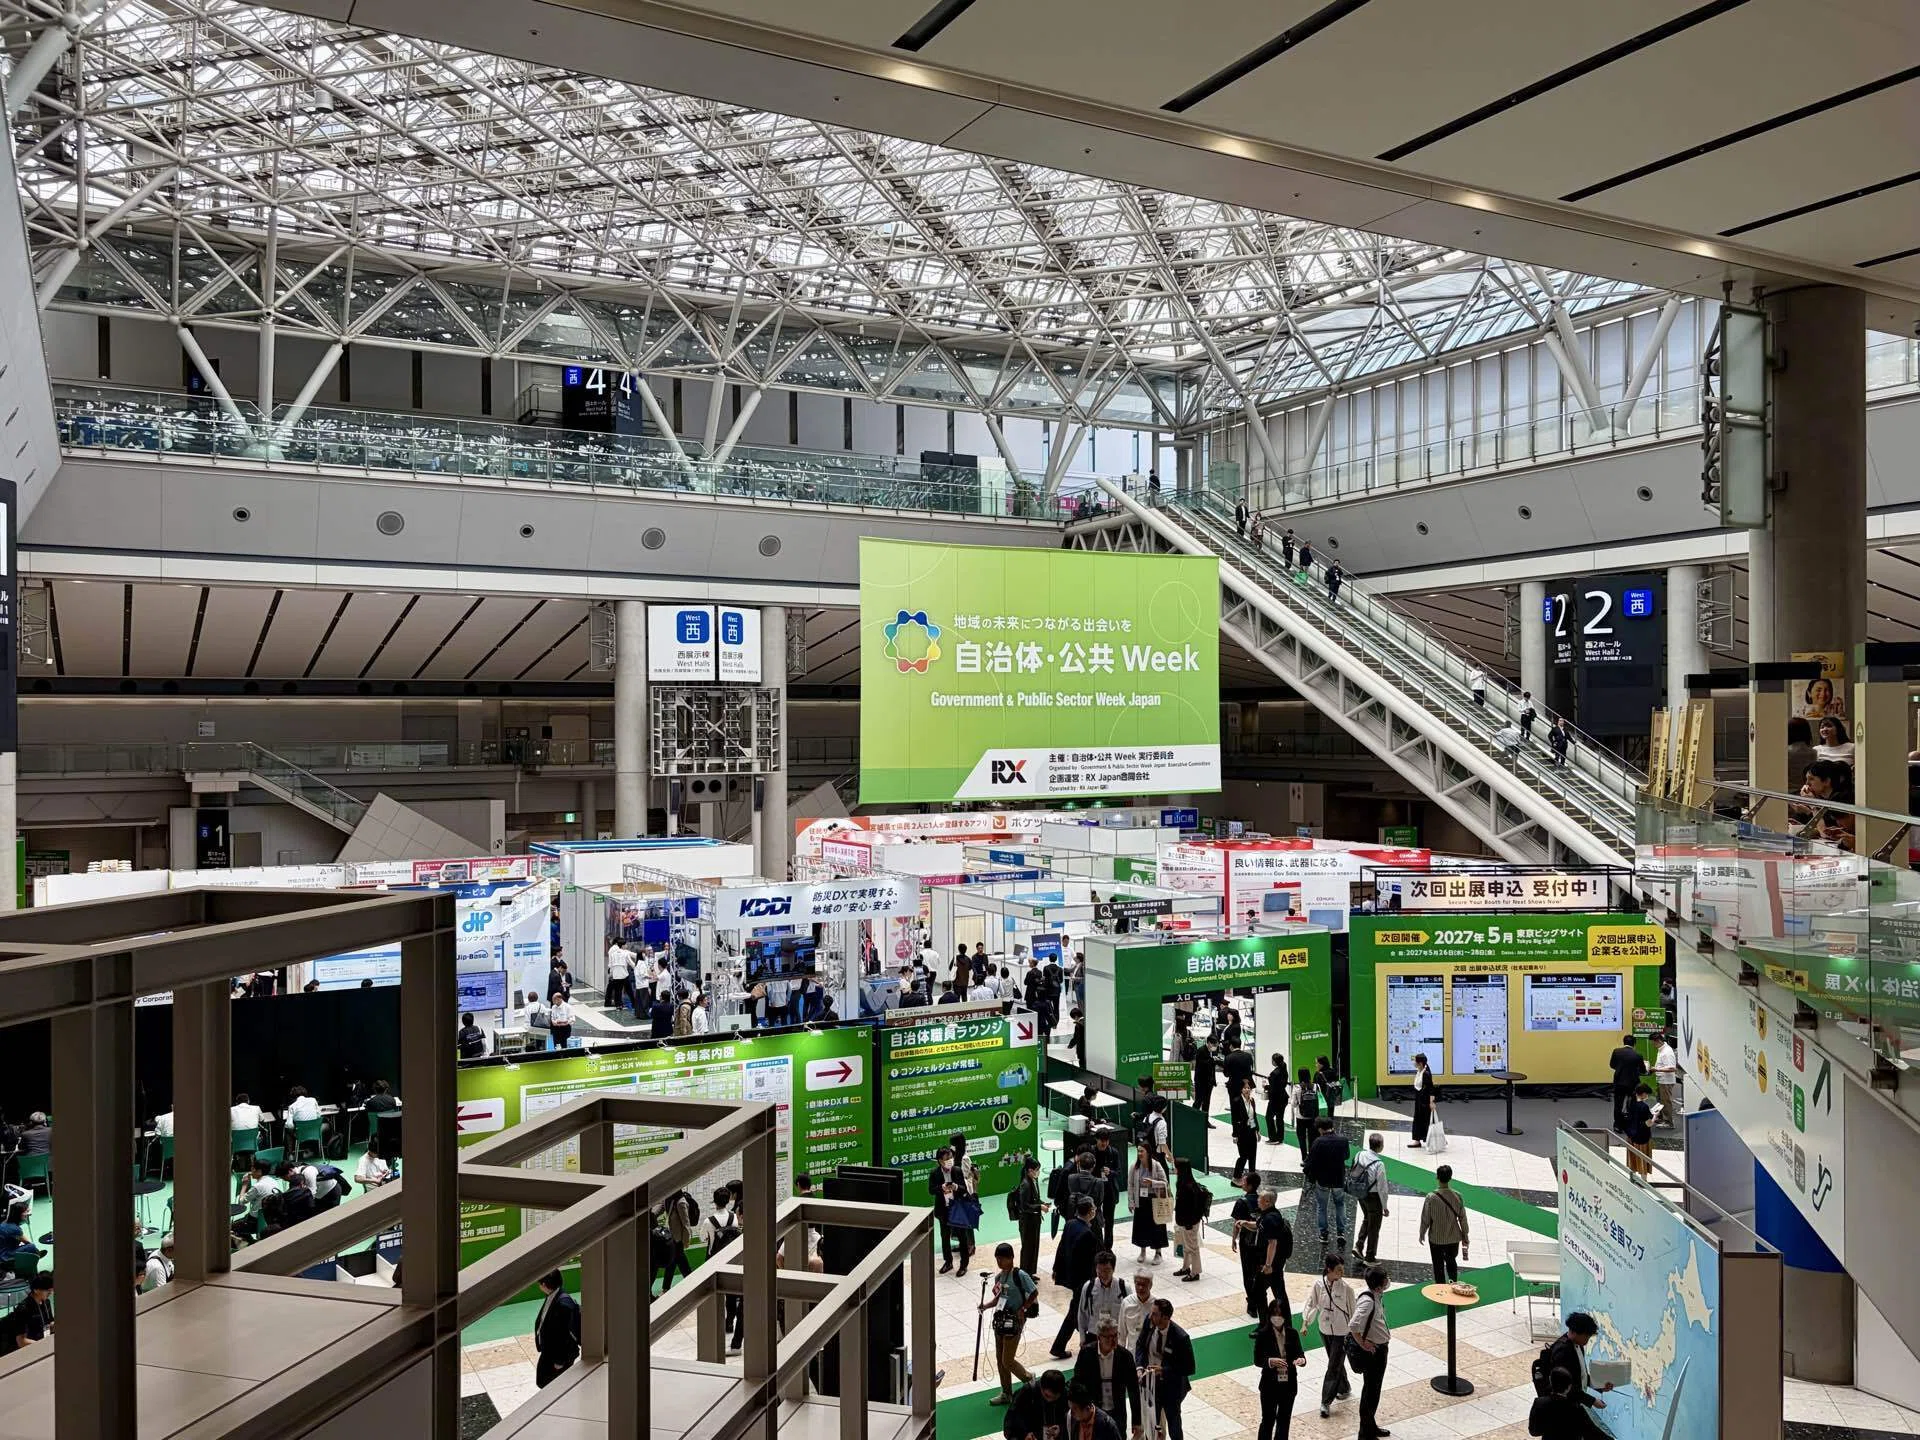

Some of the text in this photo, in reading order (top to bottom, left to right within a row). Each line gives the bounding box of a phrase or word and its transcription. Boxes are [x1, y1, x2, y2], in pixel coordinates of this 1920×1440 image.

[586, 368, 607, 395] 4
[620, 371, 632, 400] 4
[1583, 590, 1613, 635] 2
[1631, 599, 1645, 614] 西
[686, 623, 701, 641] 西
[954, 614, 1132, 633] 地域の未来につながる出会いを
[727, 624, 738, 642] 西
[955, 640, 1201, 675] 自治体・公共 Week
[931, 691, 1161, 709] Government & Public Sector Week Japan
[1115, 752, 1137, 761] Week
[1138, 751, 1174, 760] 実行委員会
[991, 759, 1028, 784] RX
[1173, 814, 1195, 824] 山口県
[215, 825, 223, 847] 1
[1235, 857, 1344, 868] 良い情報は、武器になる。
[812, 887, 899, 901] 防災DXで実現する、
[1411, 879, 1597, 898] 次回出展申込 受付中！
[740, 896, 792, 917] KDDI
[1381, 934, 1421, 943] 次回開催
[1516, 928, 1584, 938] 東京ビッグサイト
[1597, 934, 1657, 945] 次回出展申込
[1280, 951, 1307, 966] A会場
[1591, 945, 1663, 956] 企業名を公開中！
[1187, 952, 1266, 974] 自治体DX展
[1189, 975, 1218, 983] Government
[1218, 973, 1234, 981] Digital
[1235, 971, 1269, 979] Transformation
[1177, 993, 1191, 1001] 入口
[891, 1020, 1003, 1048] 自治体職員ラウンジ
[674, 1046, 735, 1064] 会場案内図
[838, 1125, 857, 1134] EXPO
[839, 1140, 858, 1149] EXPO
